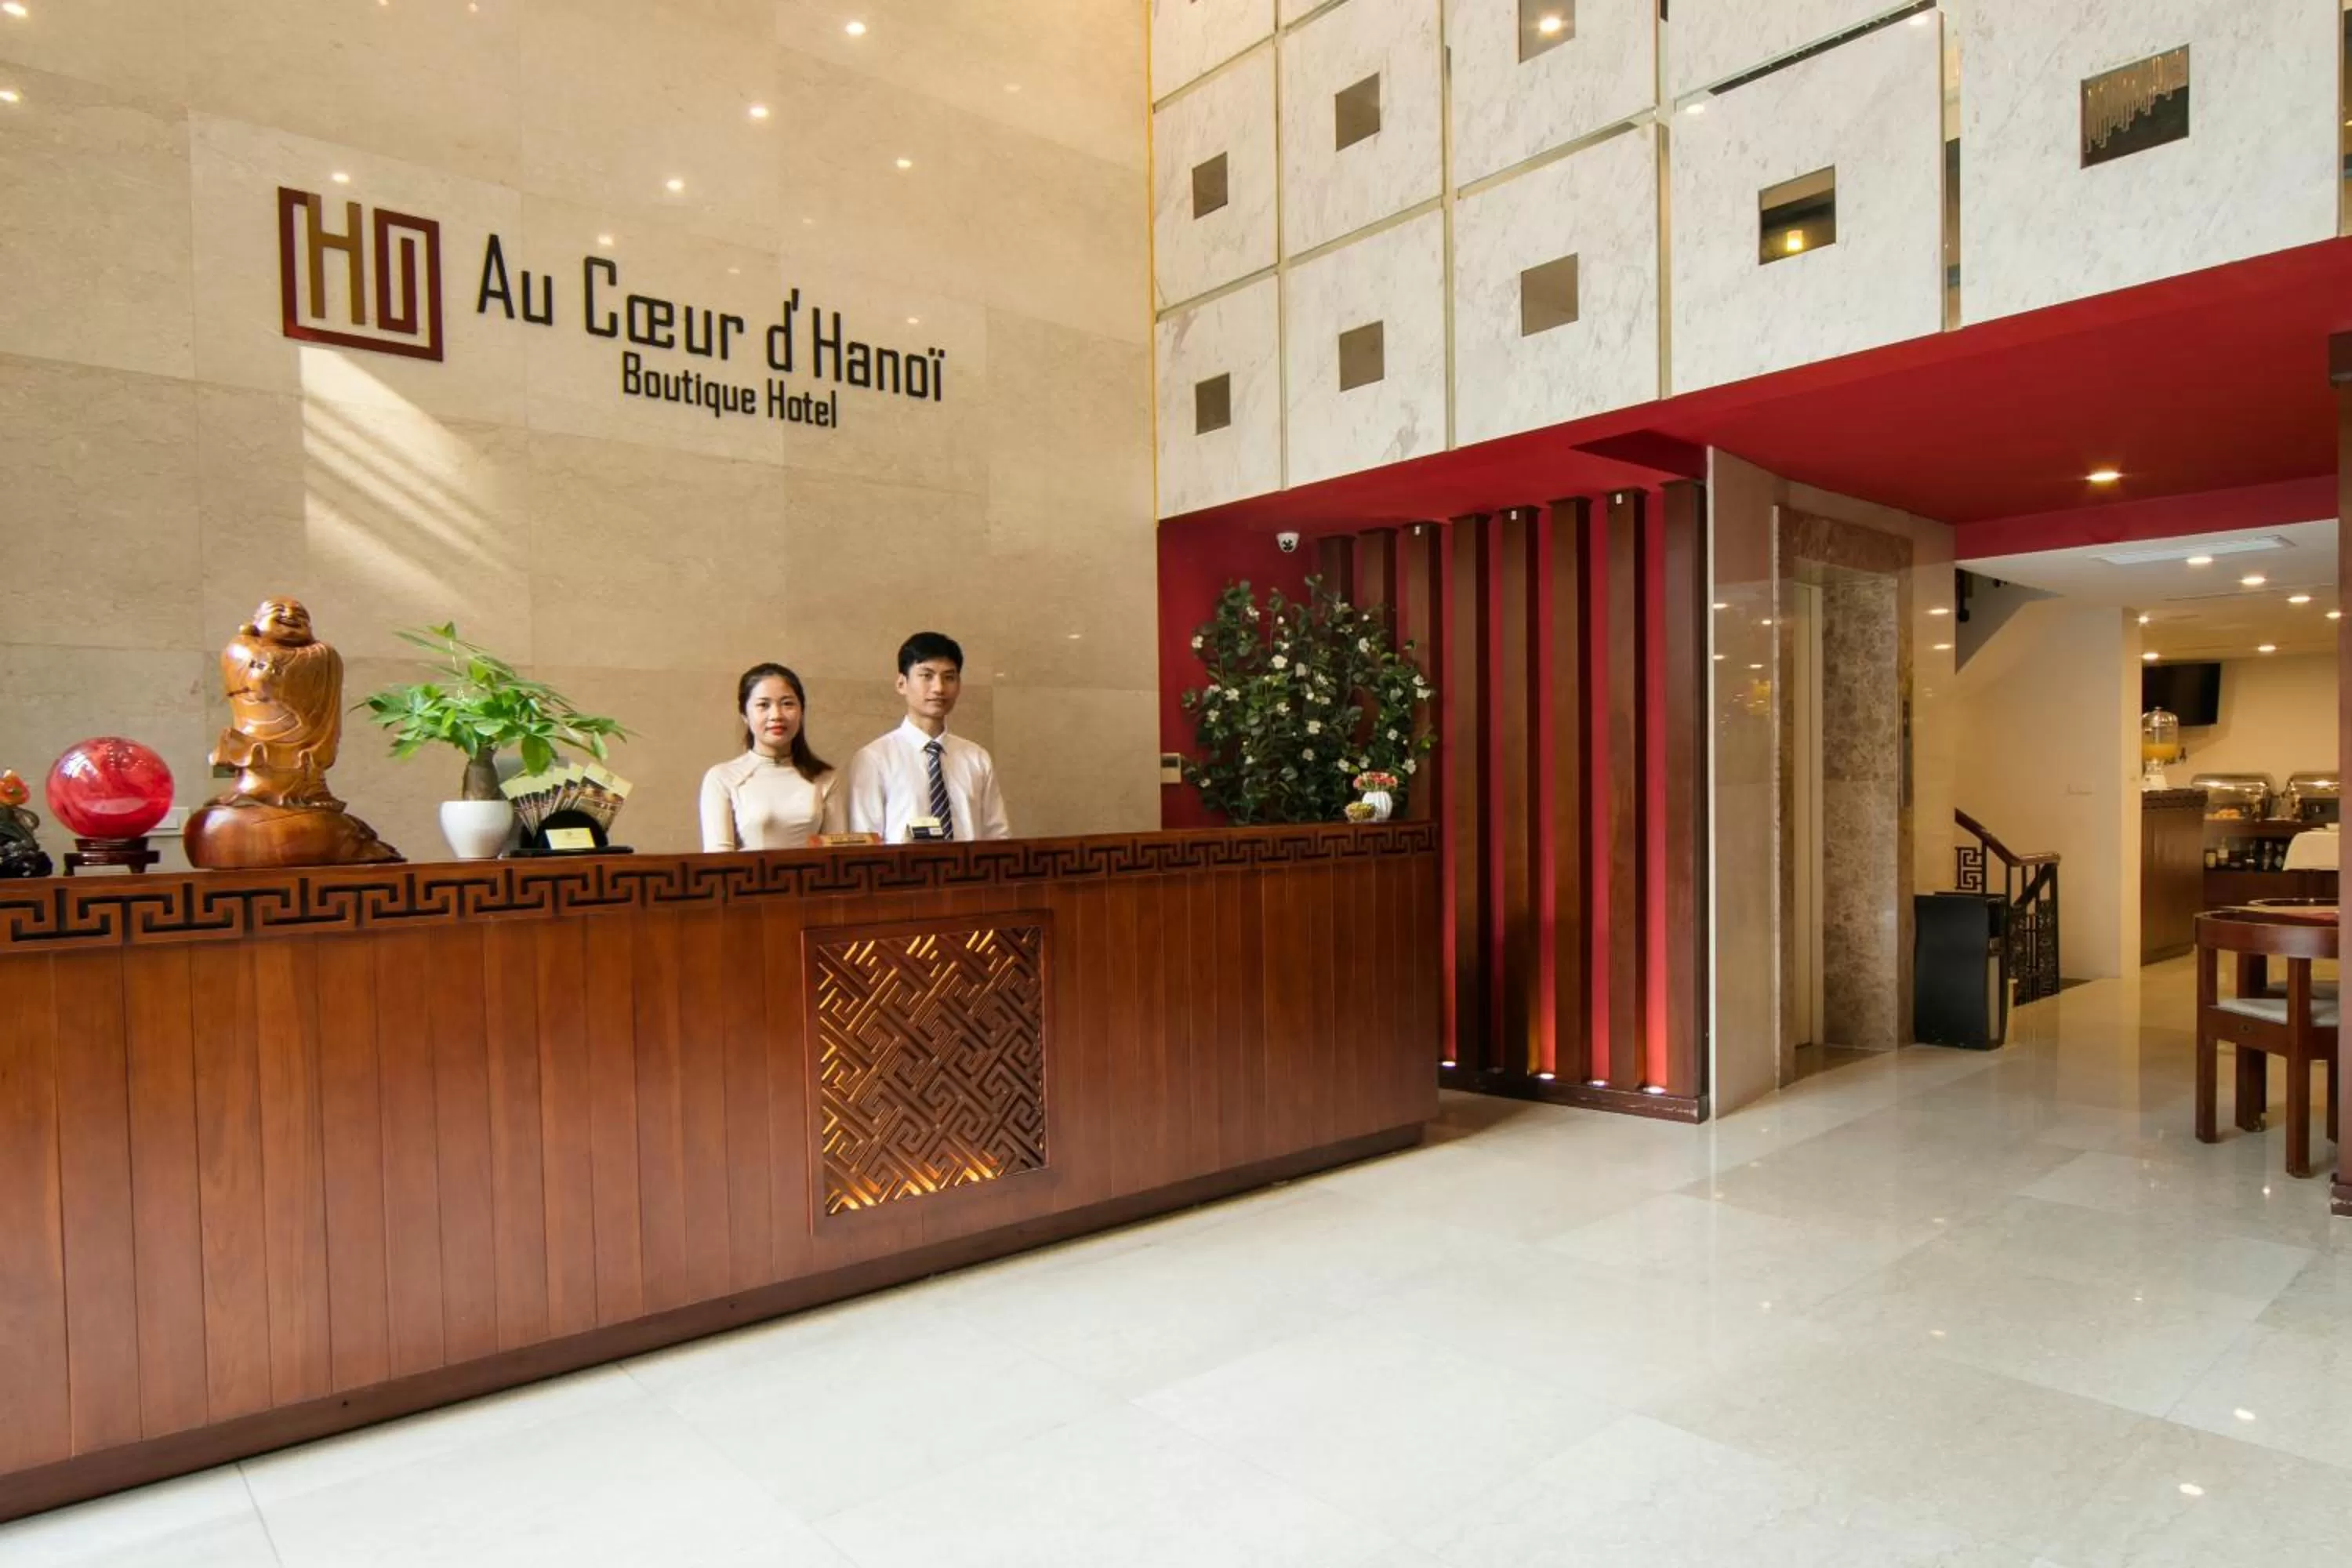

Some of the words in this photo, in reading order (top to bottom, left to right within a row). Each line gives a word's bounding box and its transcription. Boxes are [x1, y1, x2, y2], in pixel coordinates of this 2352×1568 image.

[477, 234, 554, 327] Au
[583, 256, 745, 361] Cœur
[622, 351, 757, 419] Boutique
[767, 379, 837, 429] Hotel
